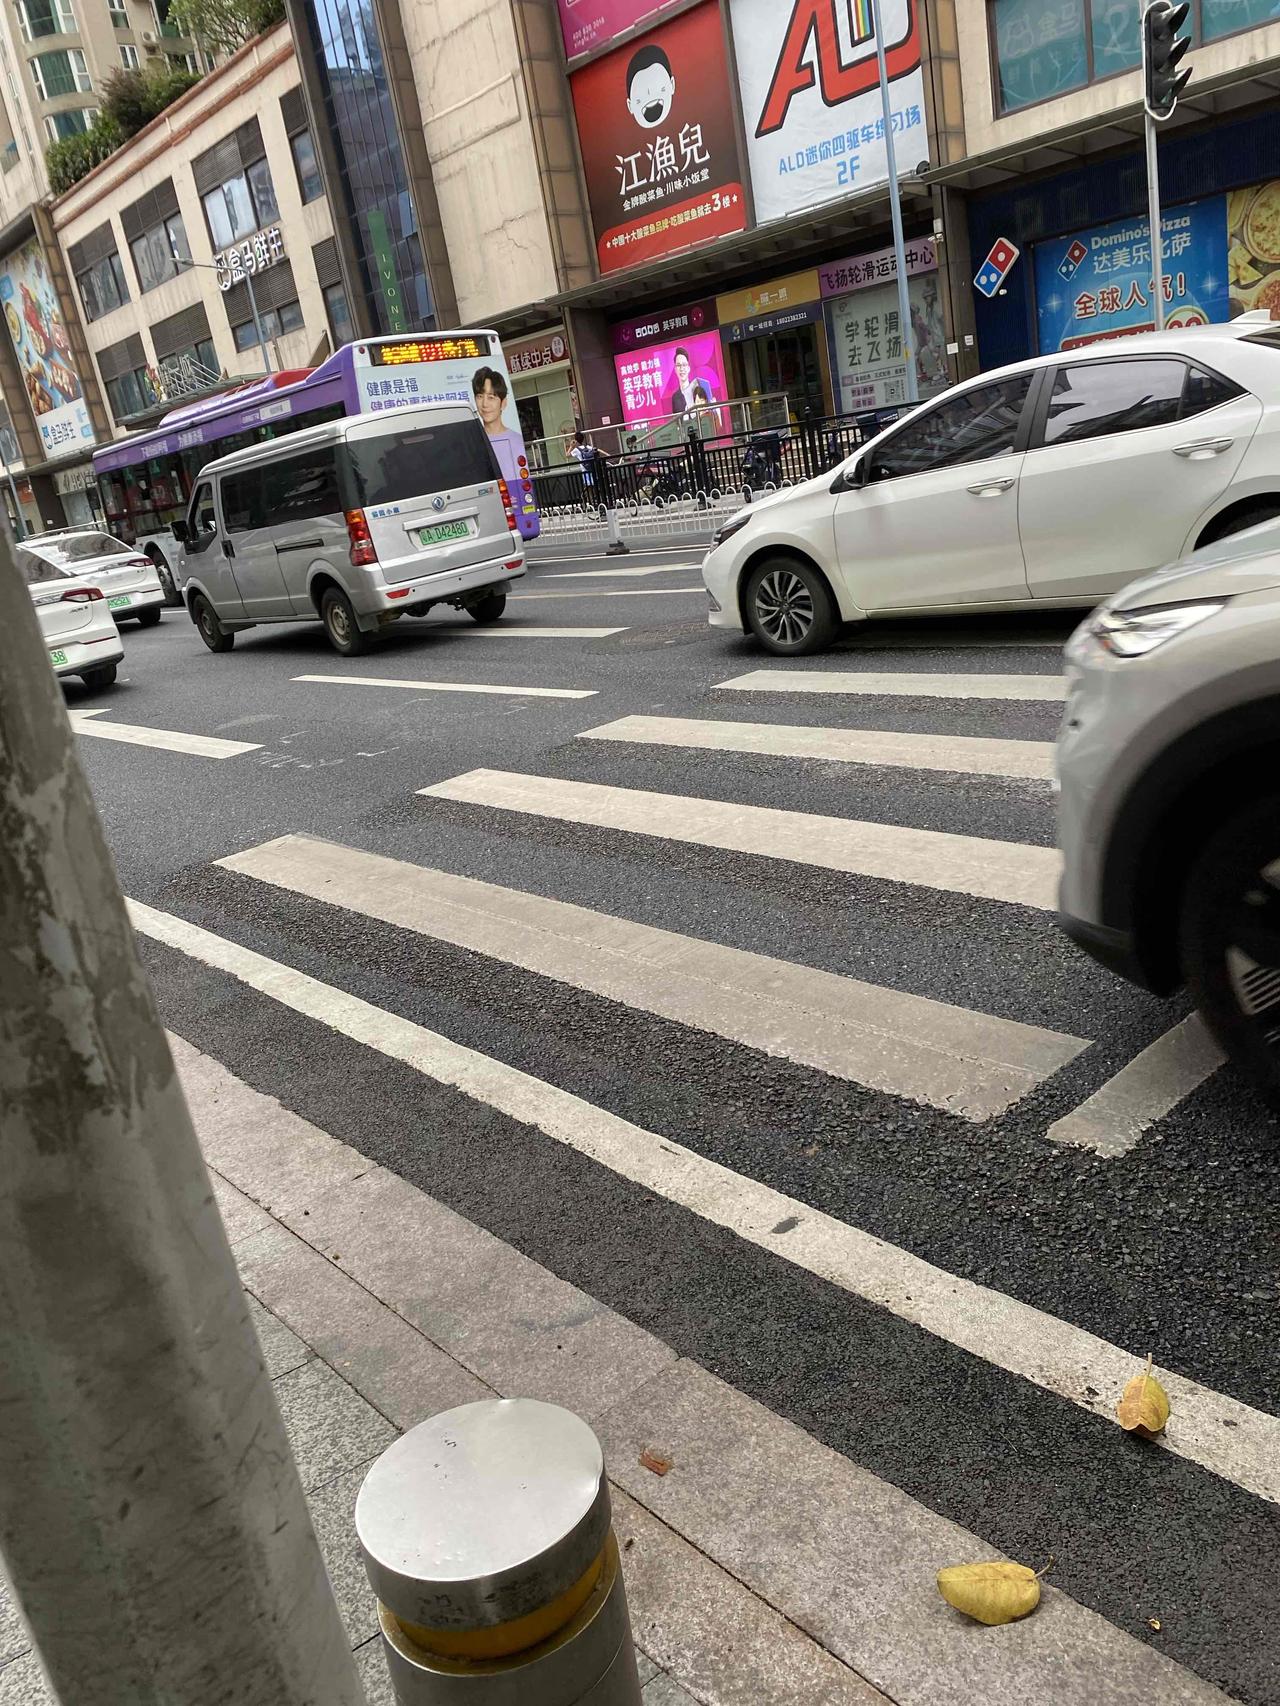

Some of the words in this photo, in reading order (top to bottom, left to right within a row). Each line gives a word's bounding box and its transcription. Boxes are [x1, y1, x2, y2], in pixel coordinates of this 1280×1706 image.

[614, 122, 711, 196] 江漁兒
[836, 155, 861, 186] 2F
[1090, 224, 1151, 250] Domino's
[1158, 215, 1192, 232] izza
[844, 311, 900, 343] 学轮滑
[848, 335, 902, 367] 去飞扬
[366, 377, 419, 397] 健康是福
[622, 370, 663, 394] 英孚教育
[625, 390, 657, 410] 青少儿
